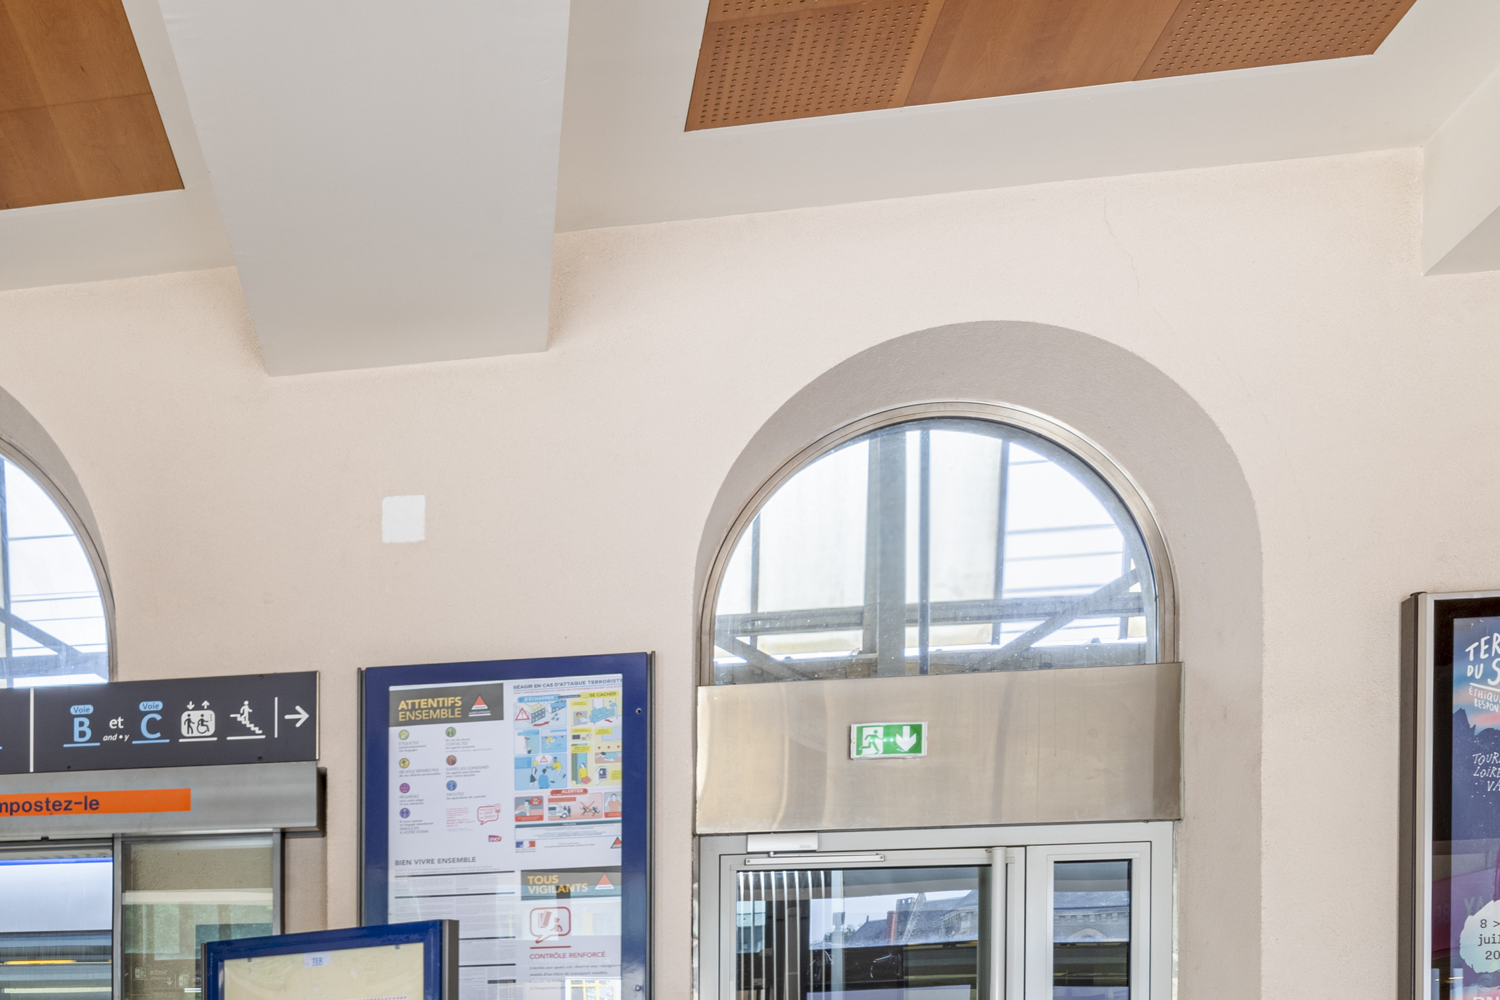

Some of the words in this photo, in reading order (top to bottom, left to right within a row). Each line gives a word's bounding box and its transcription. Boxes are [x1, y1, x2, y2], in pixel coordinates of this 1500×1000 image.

[1467, 663, 1484, 679] DU
[142, 702, 160, 710] Voie
[398, 696, 462, 711] ATTENTIFS
[1474, 698, 1500, 713] RESPON
[73, 705, 91, 714] Voie
[398, 707, 462, 721] ENSEMBLE
[73, 717, 92, 742] B
[108, 716, 124, 729] et
[140, 713, 162, 739] C
[103, 733, 117, 741] and
[124, 734, 130, 742] y
[1472, 751, 1500, 765] TOUR
[437, 856, 476, 864] ENSEMBLE
[527, 875, 559, 885] TOUS
[527, 882, 588, 894] VIGILANTS
[1480, 918, 1488, 928] 8
[529, 952, 567, 960] CONTRÔLE
[569, 950, 606, 958] RENFORCÉ
